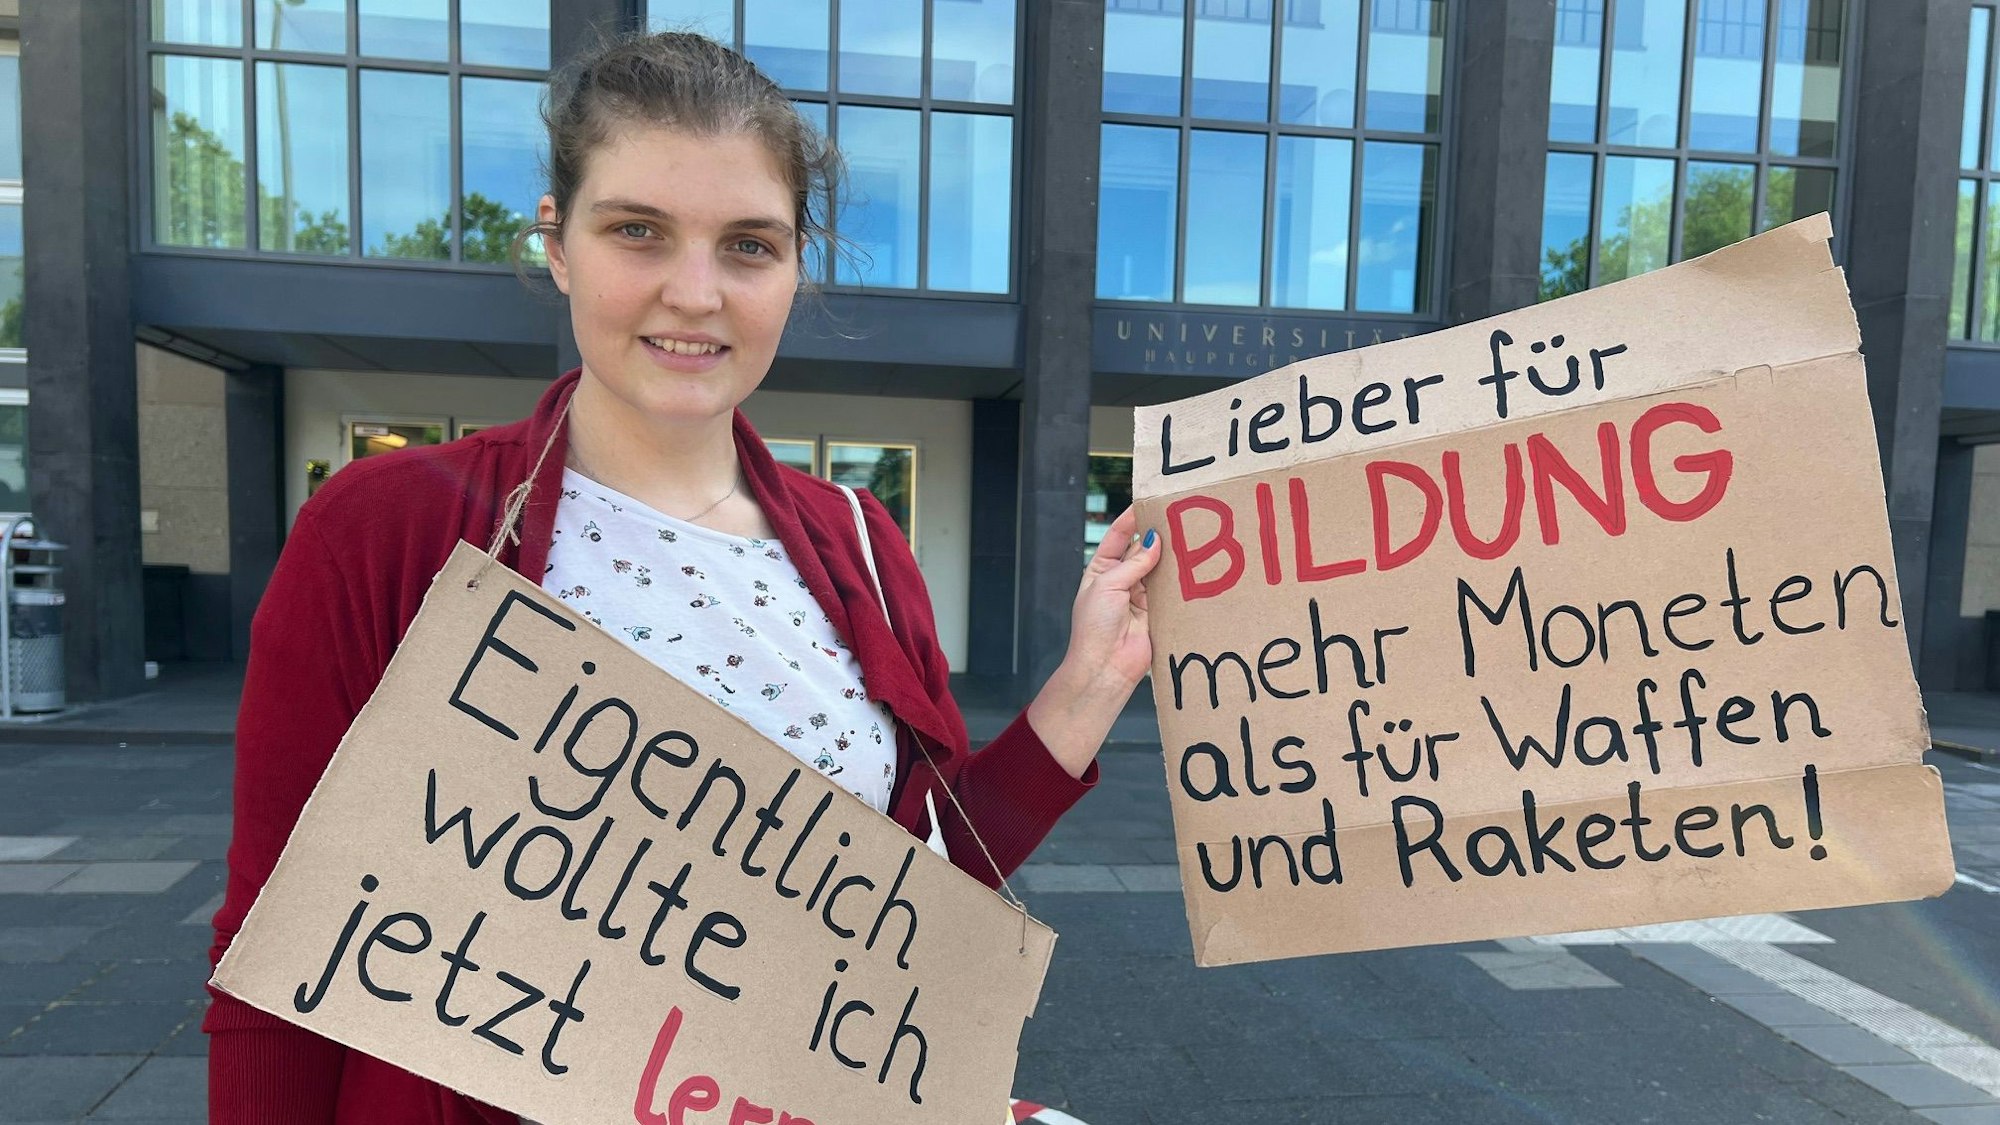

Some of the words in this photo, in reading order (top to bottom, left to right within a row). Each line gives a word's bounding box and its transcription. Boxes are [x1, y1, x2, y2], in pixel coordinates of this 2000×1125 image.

[1117, 320, 1408, 349] UNIVERSITÄ
[1162, 375, 1443, 475] Lieber
[1479, 330, 1627, 418] für
[1166, 402, 1733, 601] BILDUNG
[1169, 599, 1408, 710] mehr
[1458, 548, 1898, 677] Moneten
[449, 590, 917, 970] Eigentlich
[1181, 717, 1316, 801] als
[1342, 700, 1459, 797] für
[1481, 669, 1831, 774] Waffen
[1197, 798, 1342, 892] und
[1392, 764, 1827, 888] Raketen!
[294, 875, 591, 1075] jetzt
[425, 769, 746, 1000] wollte
[809, 960, 927, 1104] ich
